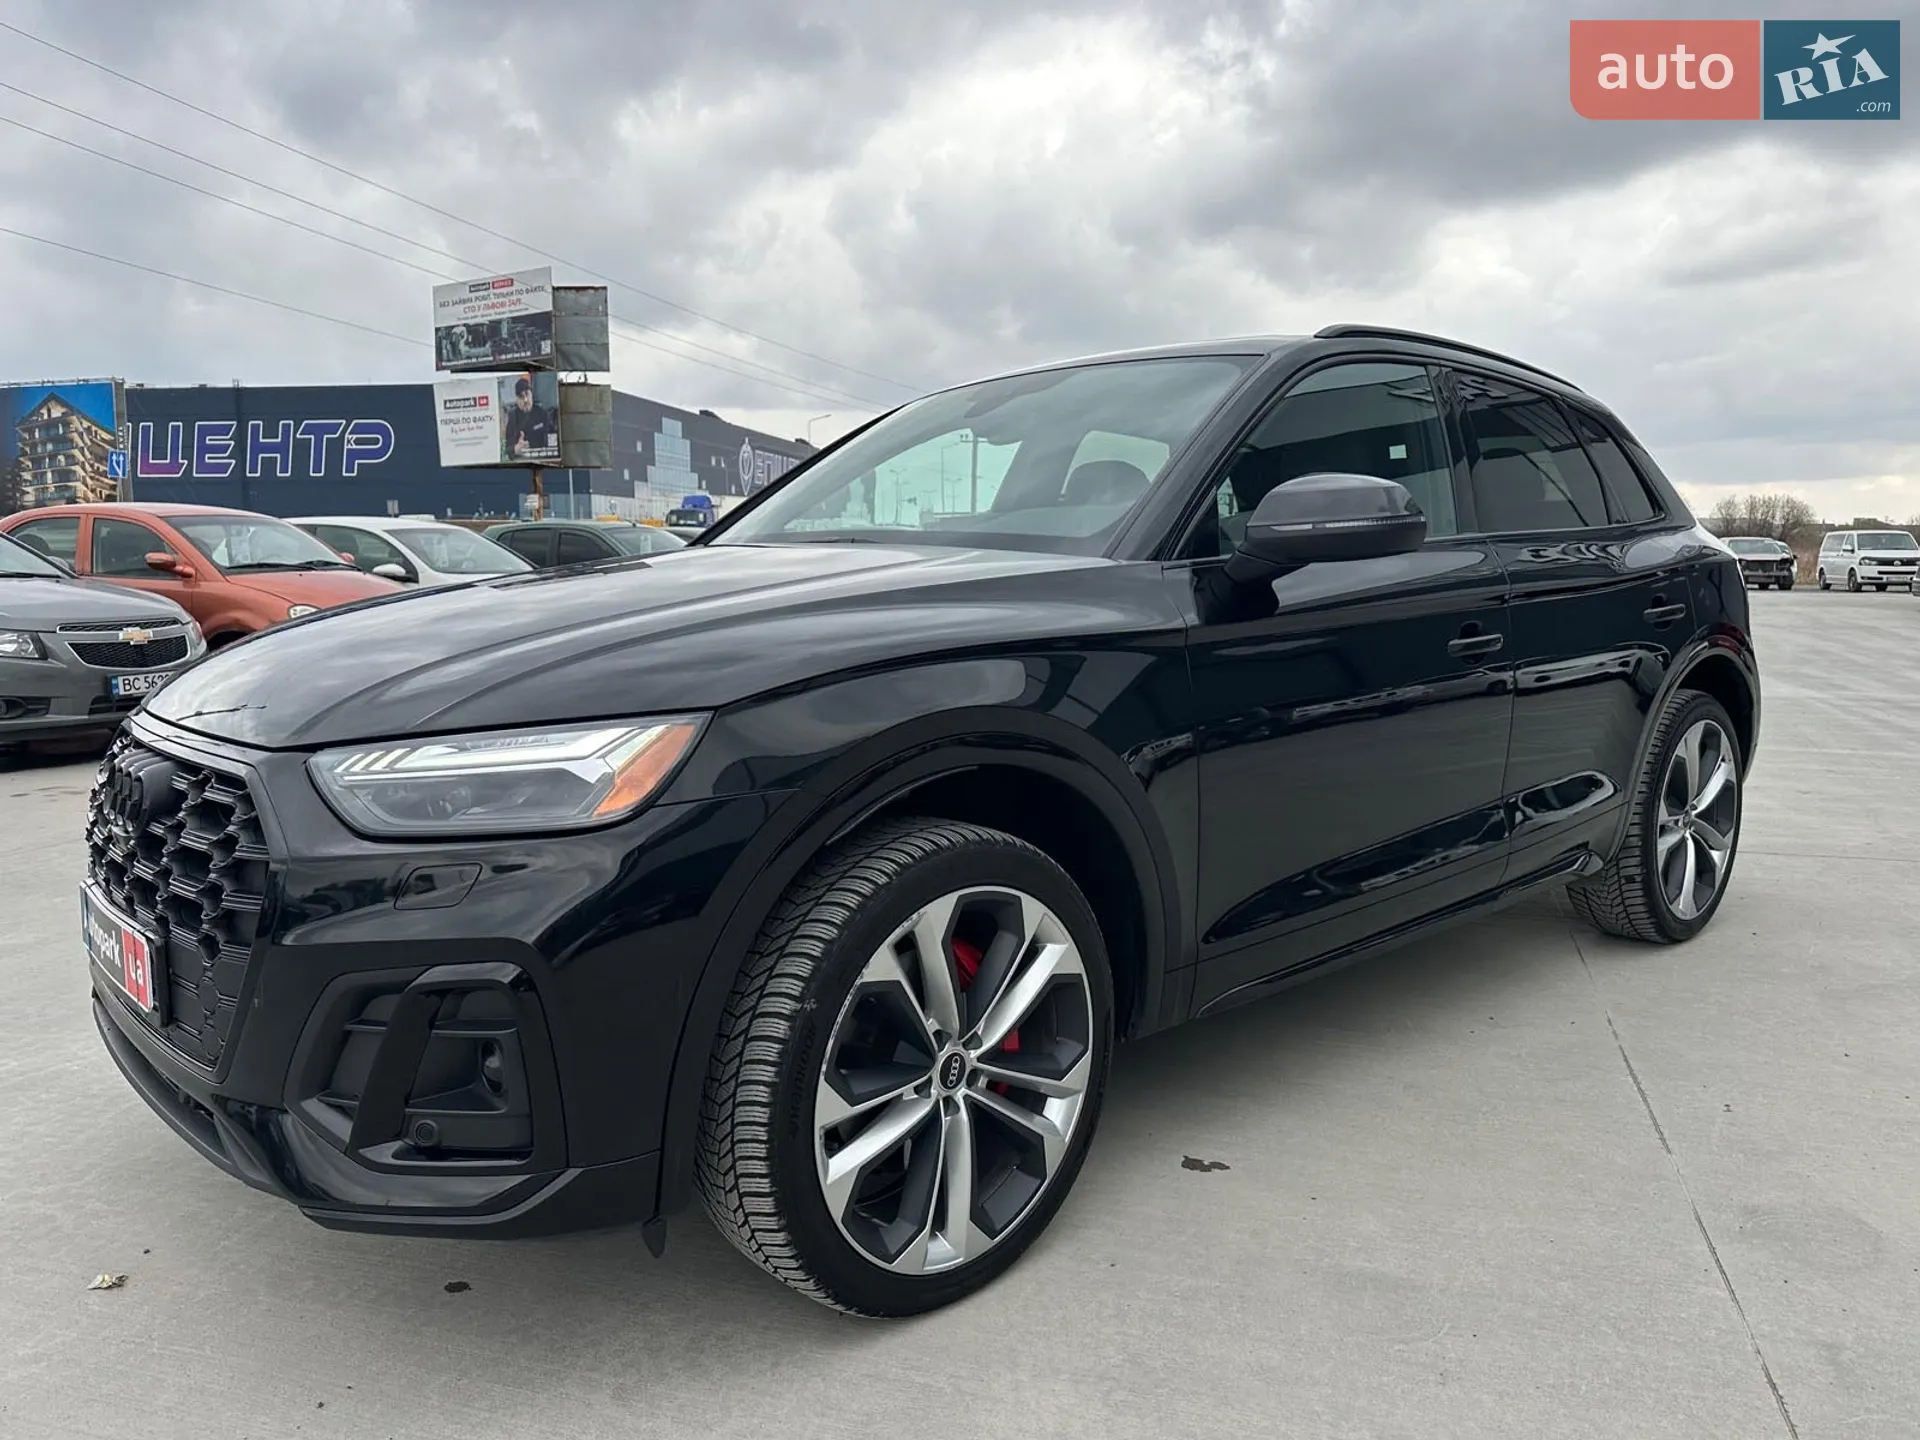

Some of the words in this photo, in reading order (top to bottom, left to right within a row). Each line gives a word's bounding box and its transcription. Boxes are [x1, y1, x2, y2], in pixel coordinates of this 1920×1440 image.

[127, 419, 395, 477] ЦЕНТР
[122, 676, 141, 692] BC
[128, 952, 144, 987] ua
